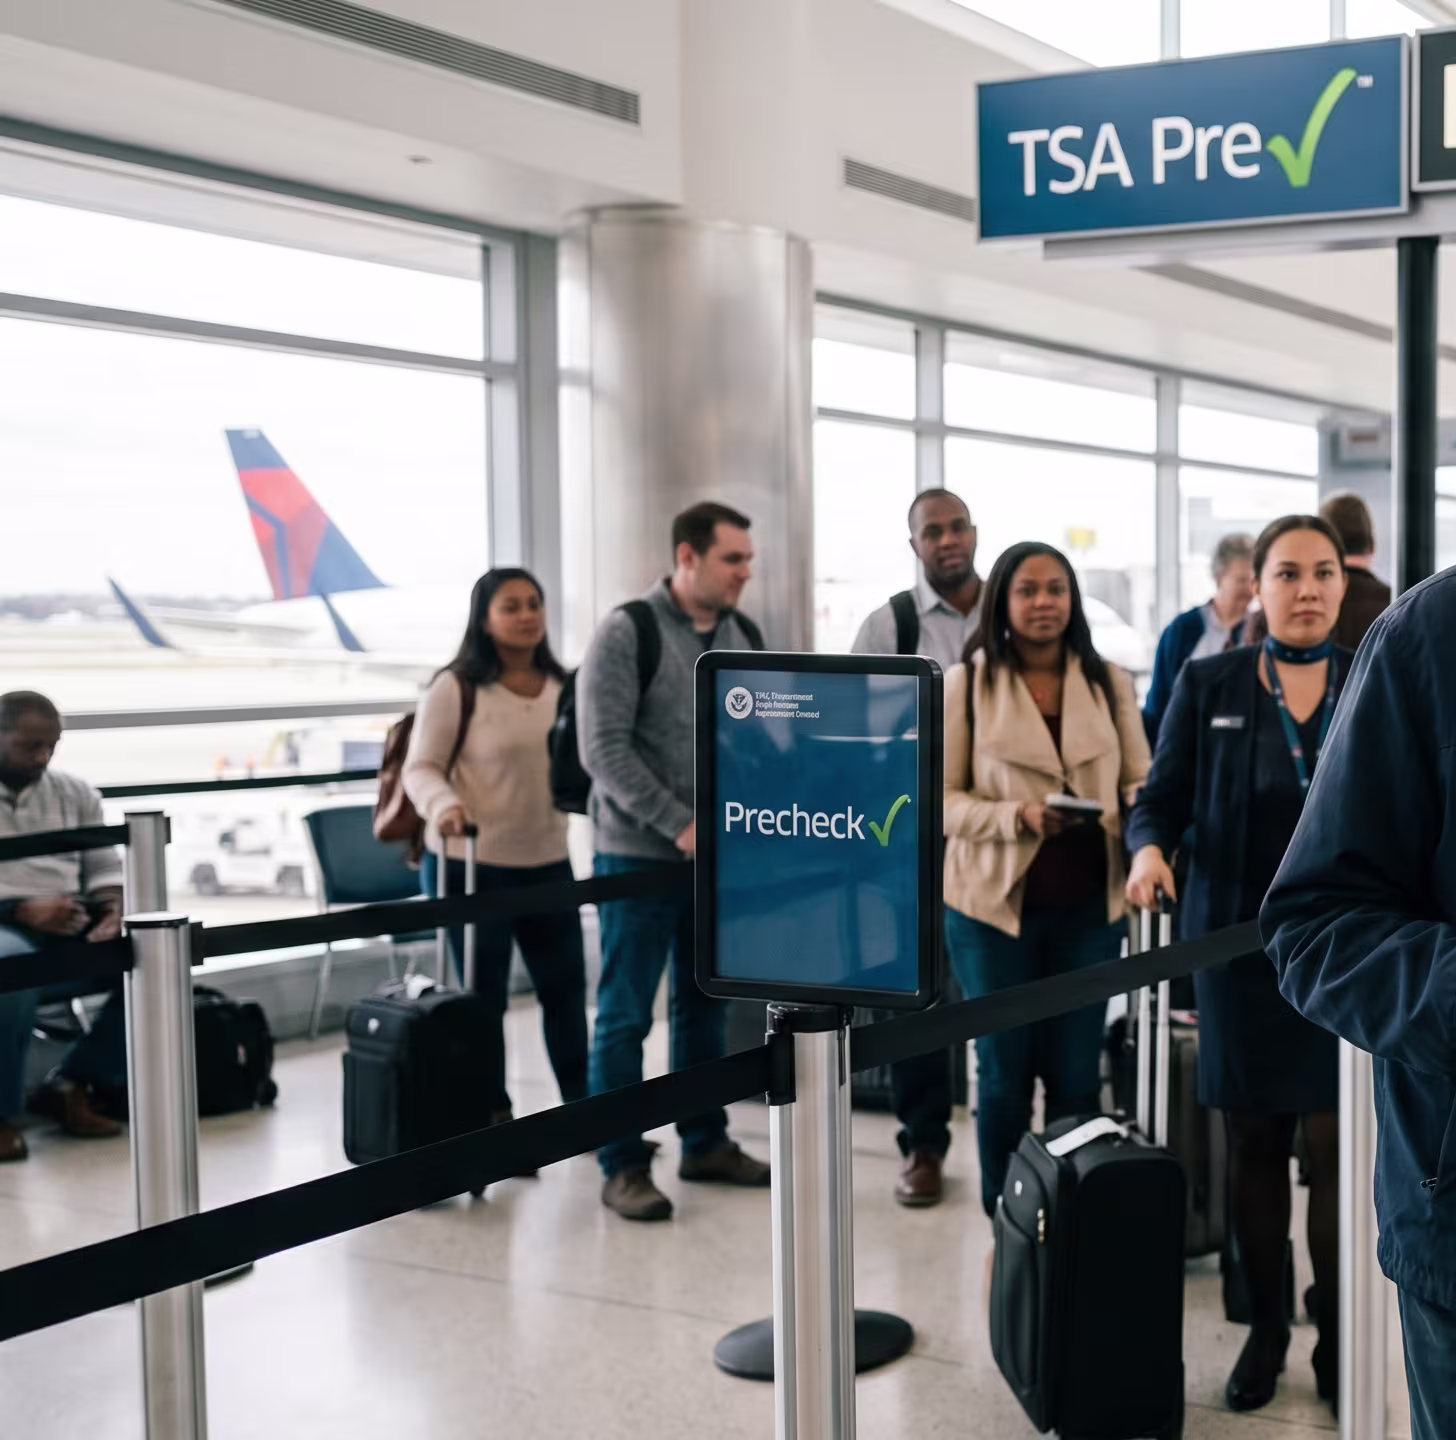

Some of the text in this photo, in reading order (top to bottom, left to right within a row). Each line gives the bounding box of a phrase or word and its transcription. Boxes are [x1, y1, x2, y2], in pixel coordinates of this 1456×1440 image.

[1007, 123, 1134, 196] TSA
[1151, 116, 1262, 184] Pre
[725, 801, 866, 840] Precheck
